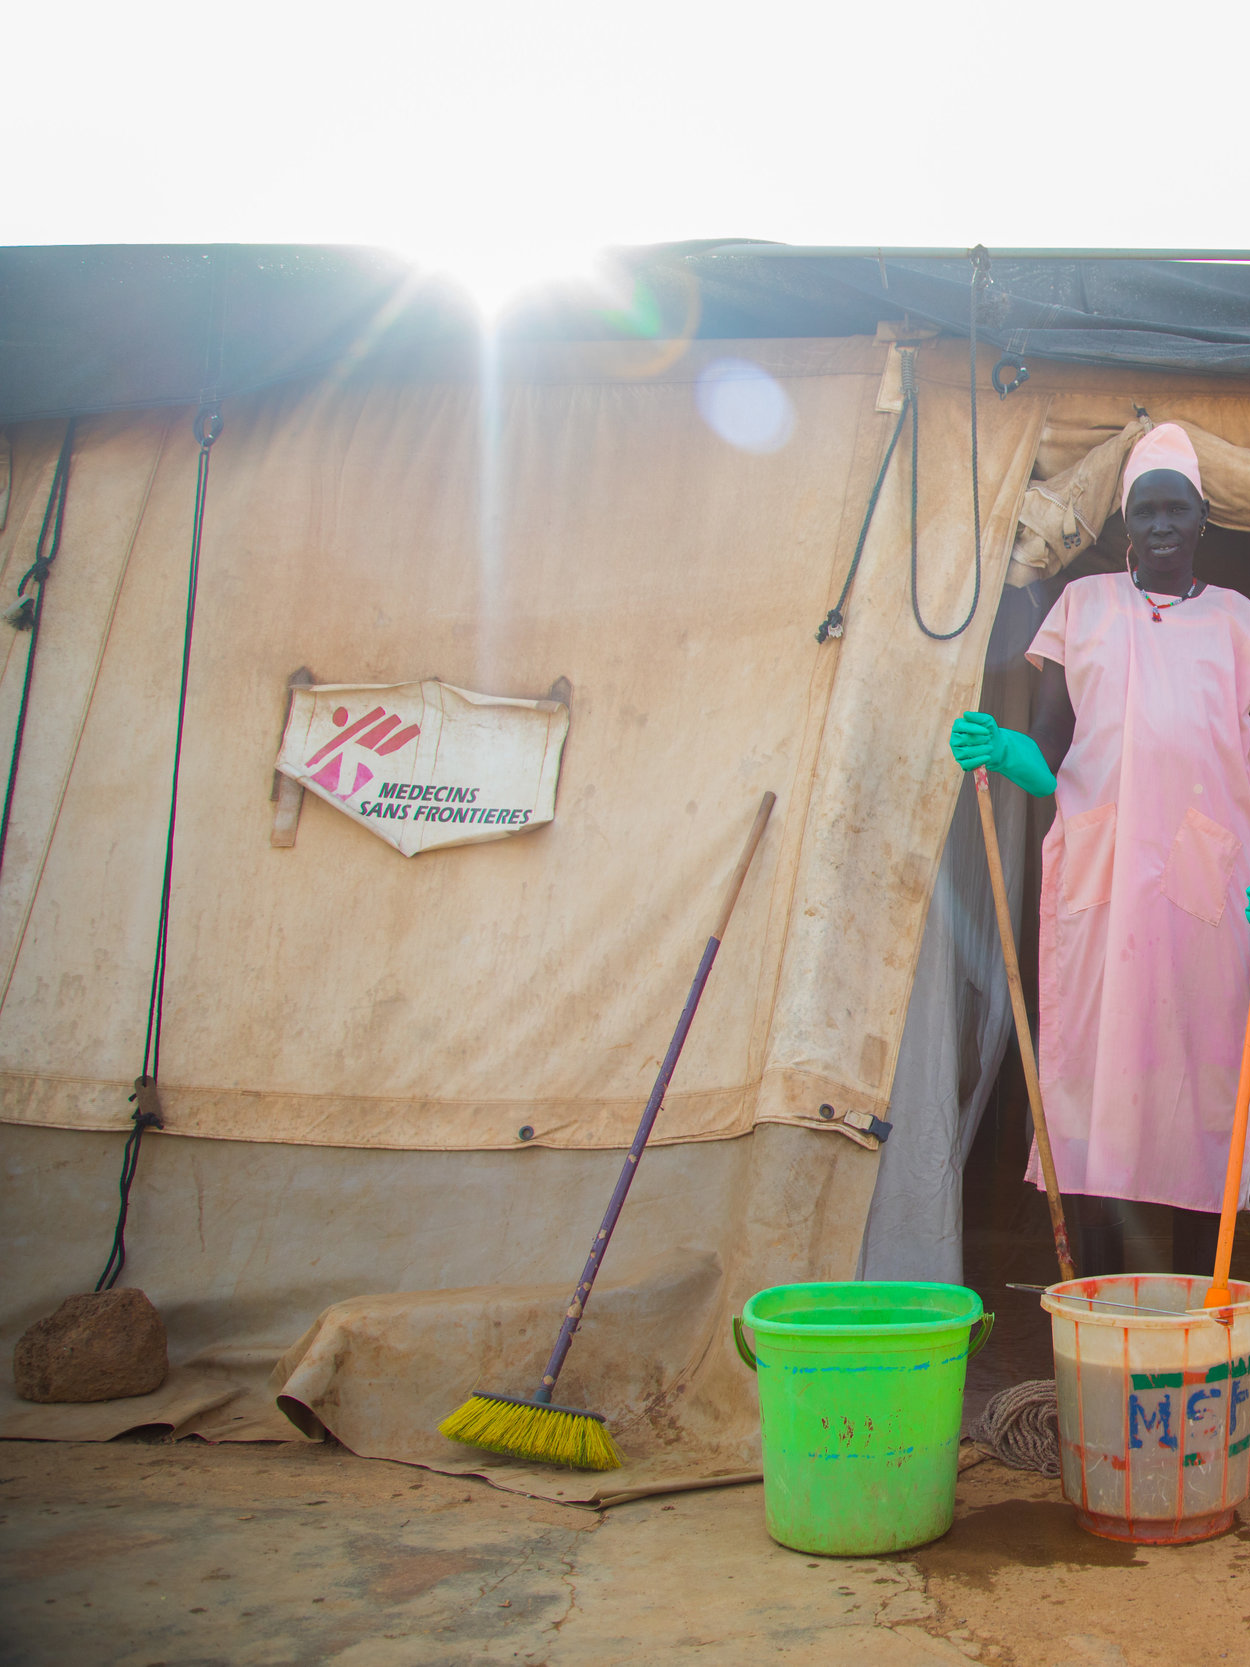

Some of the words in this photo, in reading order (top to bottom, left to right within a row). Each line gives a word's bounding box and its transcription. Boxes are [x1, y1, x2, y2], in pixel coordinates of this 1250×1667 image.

[378, 782, 480, 804] MEDECINS
[360, 800, 412, 821] SANS
[413, 805, 533, 825] FRONTIERES
